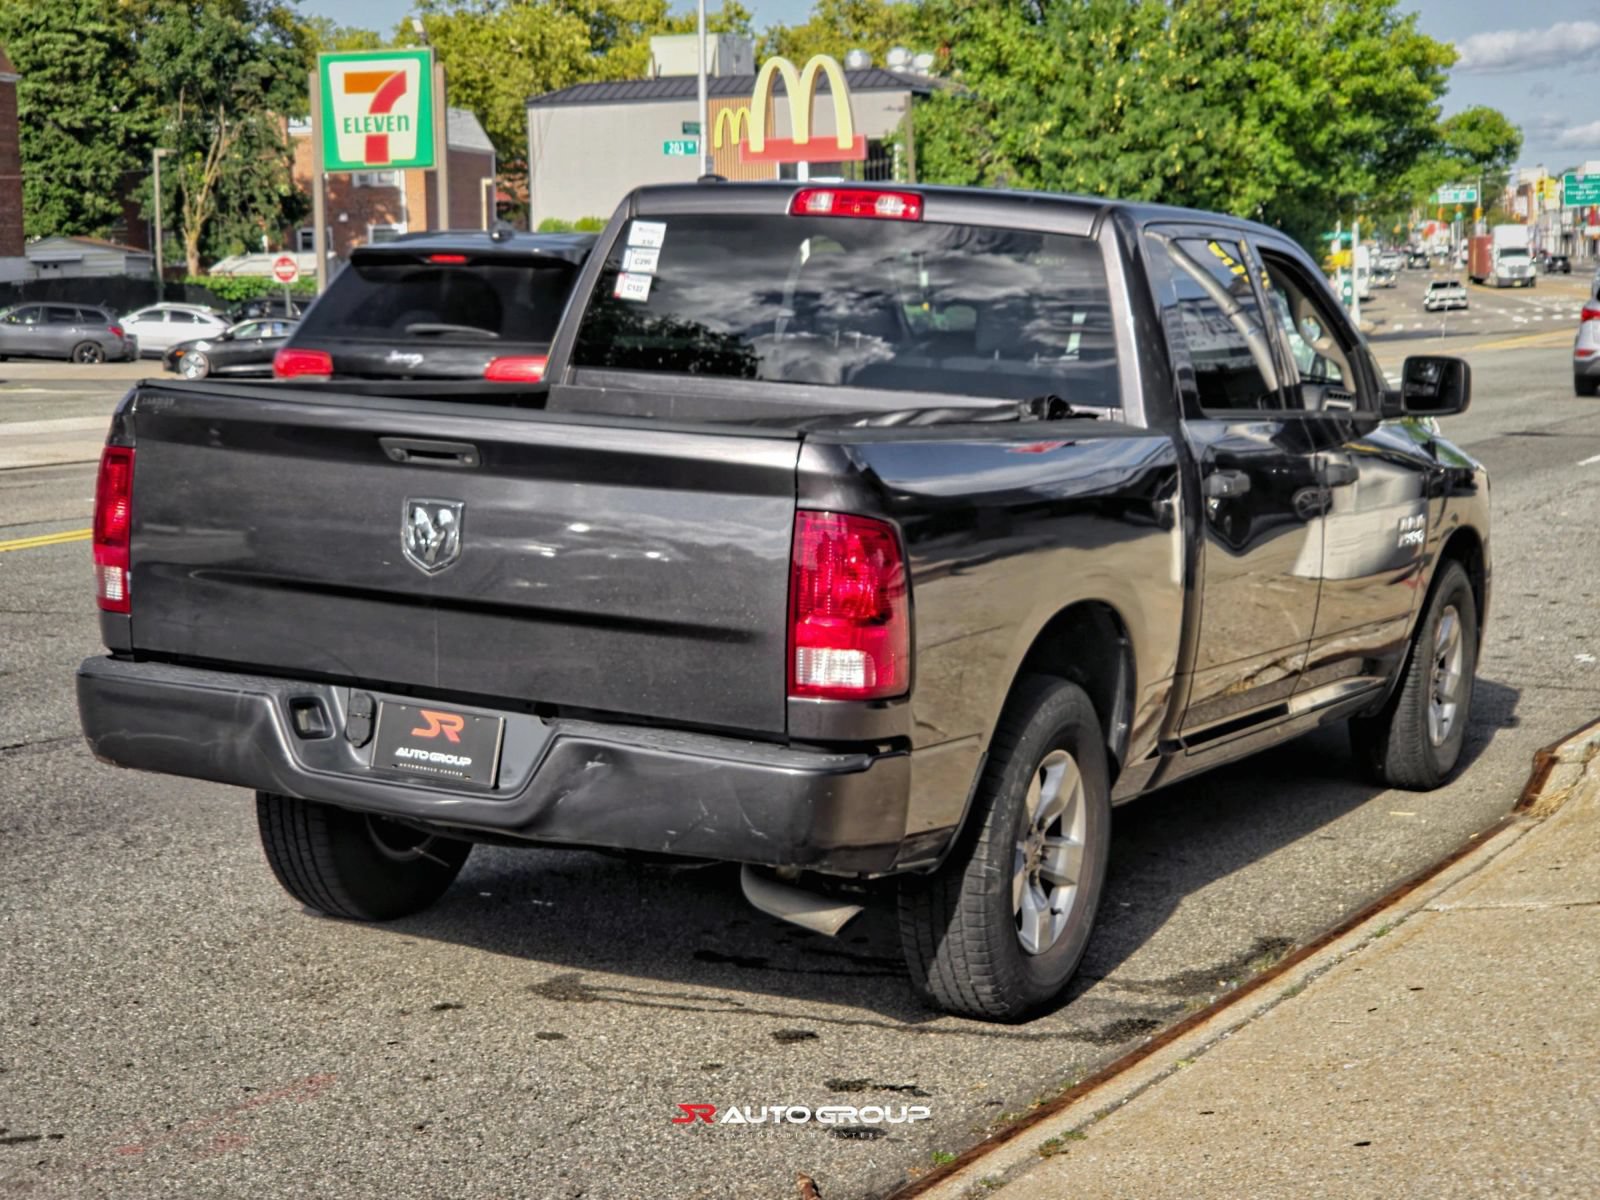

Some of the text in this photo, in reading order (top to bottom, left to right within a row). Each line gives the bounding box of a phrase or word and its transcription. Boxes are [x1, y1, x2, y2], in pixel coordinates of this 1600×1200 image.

[411, 709, 465, 743] SR
[394, 746, 473, 767] AUTO GROUP
